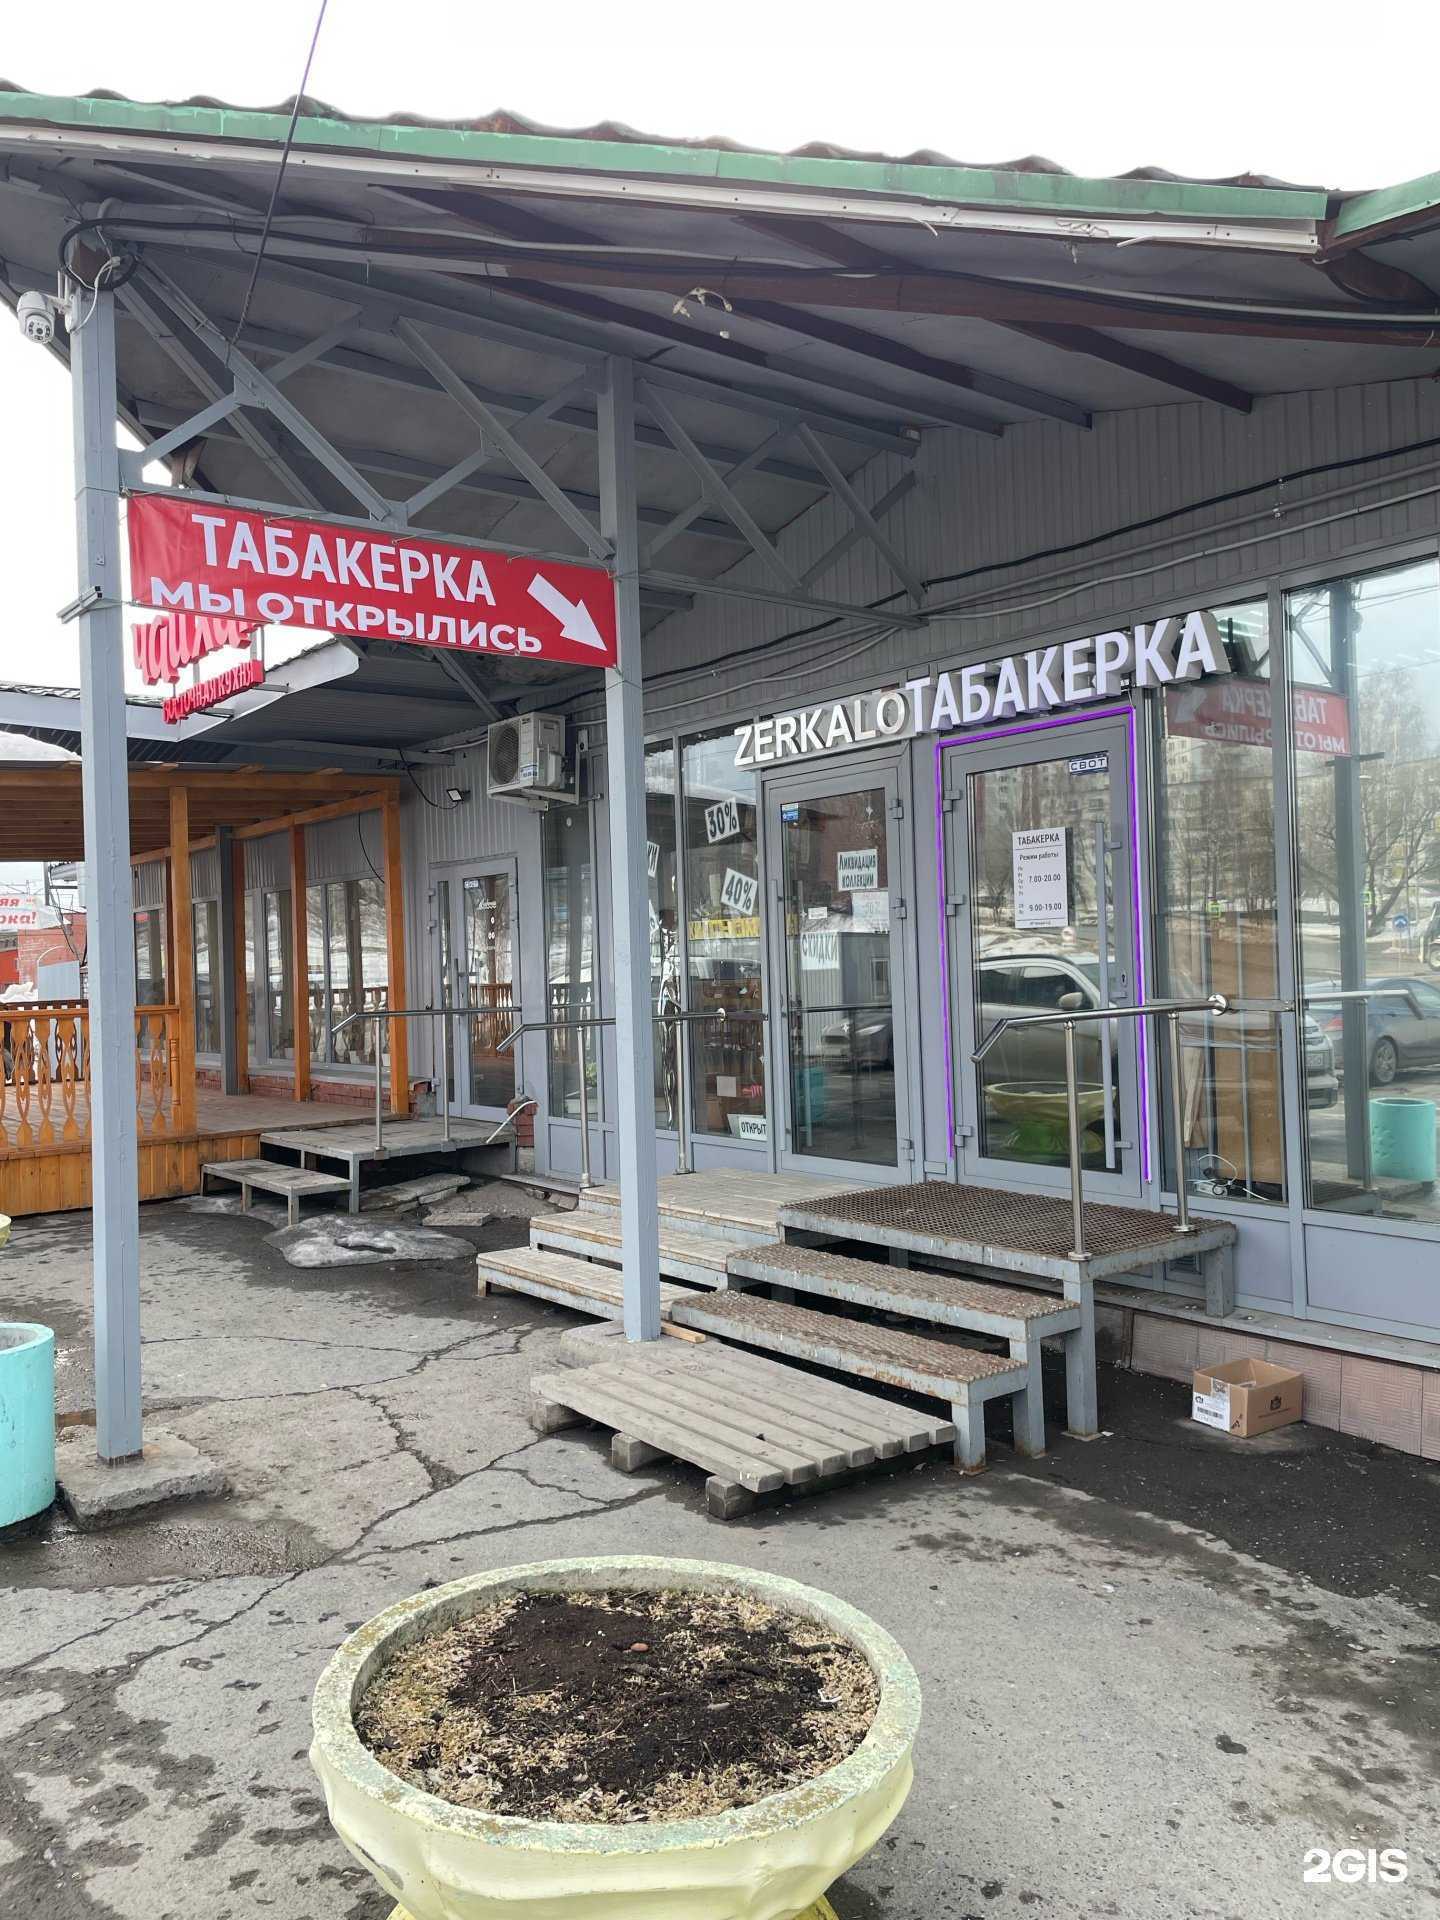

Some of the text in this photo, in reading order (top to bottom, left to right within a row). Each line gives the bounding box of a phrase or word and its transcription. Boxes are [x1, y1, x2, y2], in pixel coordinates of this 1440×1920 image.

[191, 513, 497, 606] ТАБАКЕРКА
[150, 576, 543, 654] МЫ ОТКРЫЛИСЬ
[162, 661, 256, 723] ВОСТОЧНАЯ КУХНЯ
[905, 610, 1222, 734] ТАБАКЕРКА
[734, 692, 906, 767] ZERKALO
[707, 806, 738, 840] 30%
[1017, 832, 1060, 846] ТАБАКЕРКА
[726, 874, 752, 910] 40%
